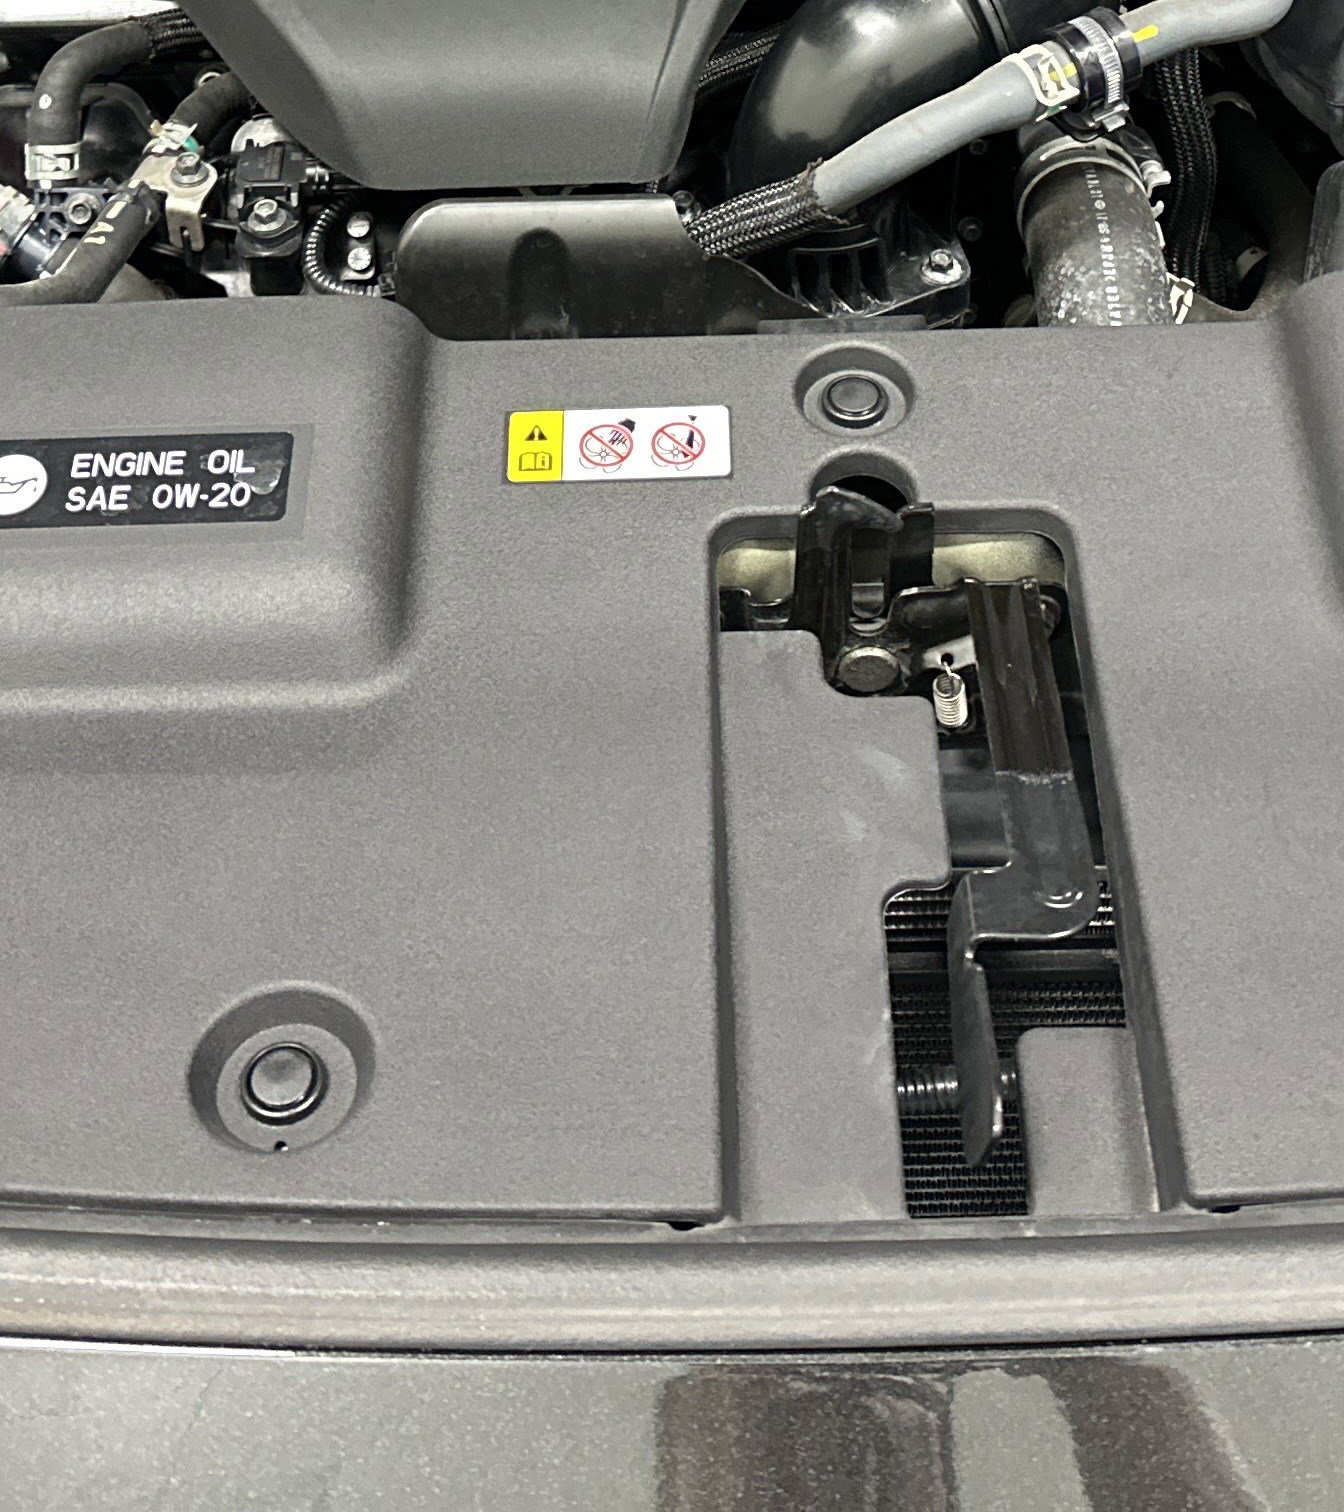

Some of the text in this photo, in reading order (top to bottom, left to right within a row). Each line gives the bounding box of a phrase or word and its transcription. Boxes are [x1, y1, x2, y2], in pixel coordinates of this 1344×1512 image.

[70, 449, 256, 478] ENGINE OIL
[65, 482, 252, 513] SAE 0W-20
